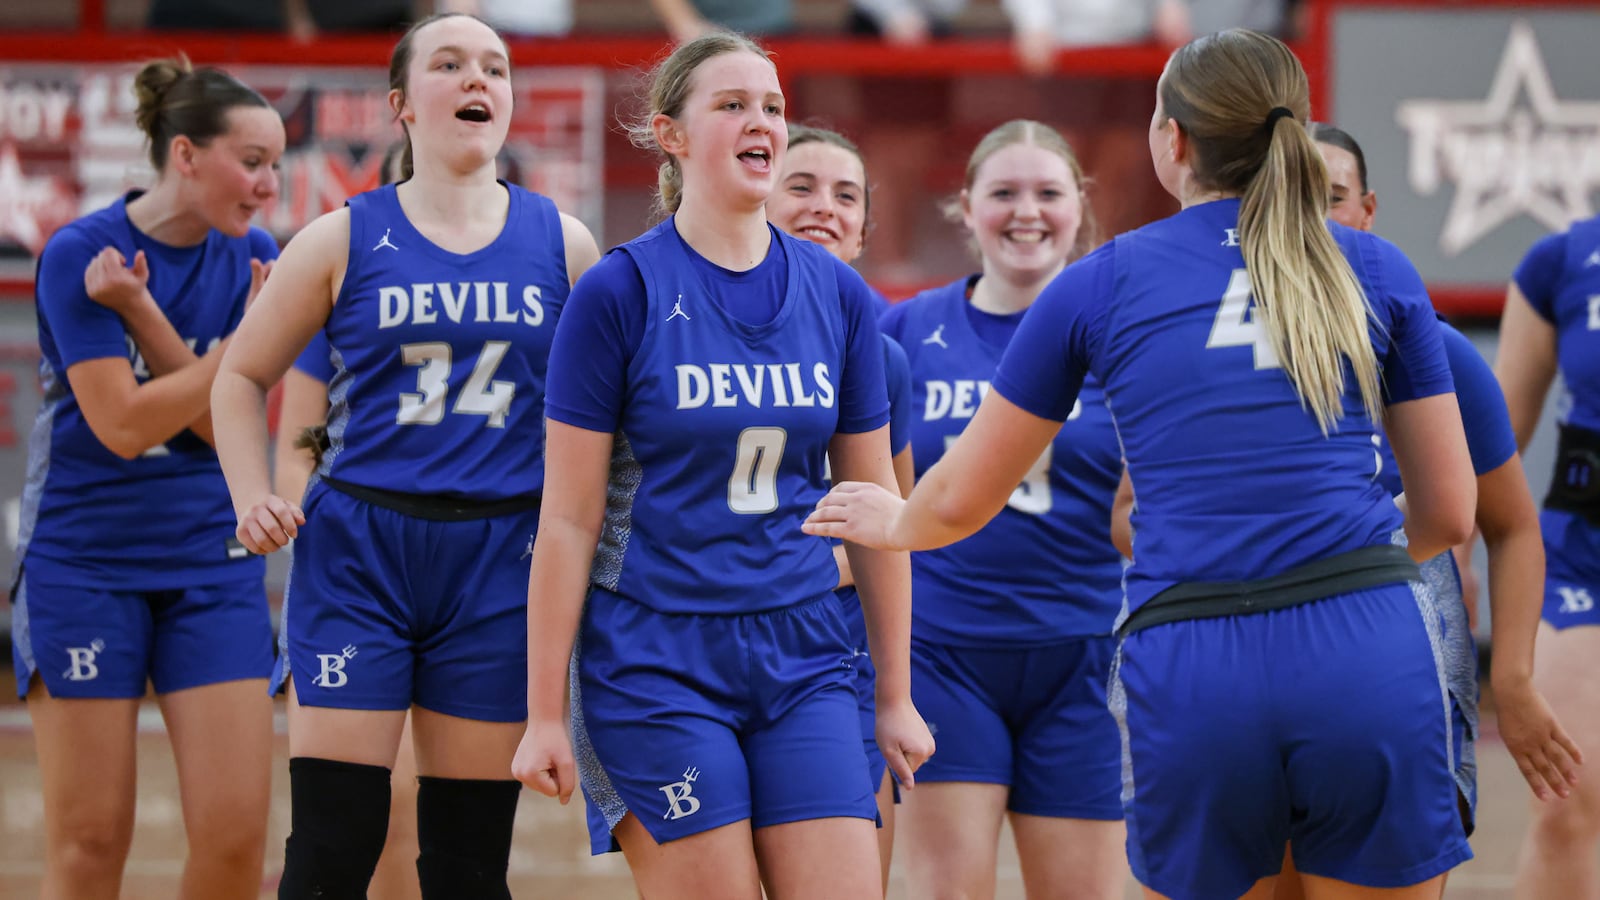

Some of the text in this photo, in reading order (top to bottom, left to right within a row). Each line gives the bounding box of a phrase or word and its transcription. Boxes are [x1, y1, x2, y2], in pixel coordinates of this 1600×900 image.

[378, 282, 544, 329] DEVILS
[1206, 268, 1284, 370] 4
[396, 341, 516, 428] 34
[675, 362, 835, 410] DEVILS
[727, 426, 788, 514] 0
[66, 648, 98, 680] B
[316, 654, 348, 687] B
[659, 781, 701, 820] B
